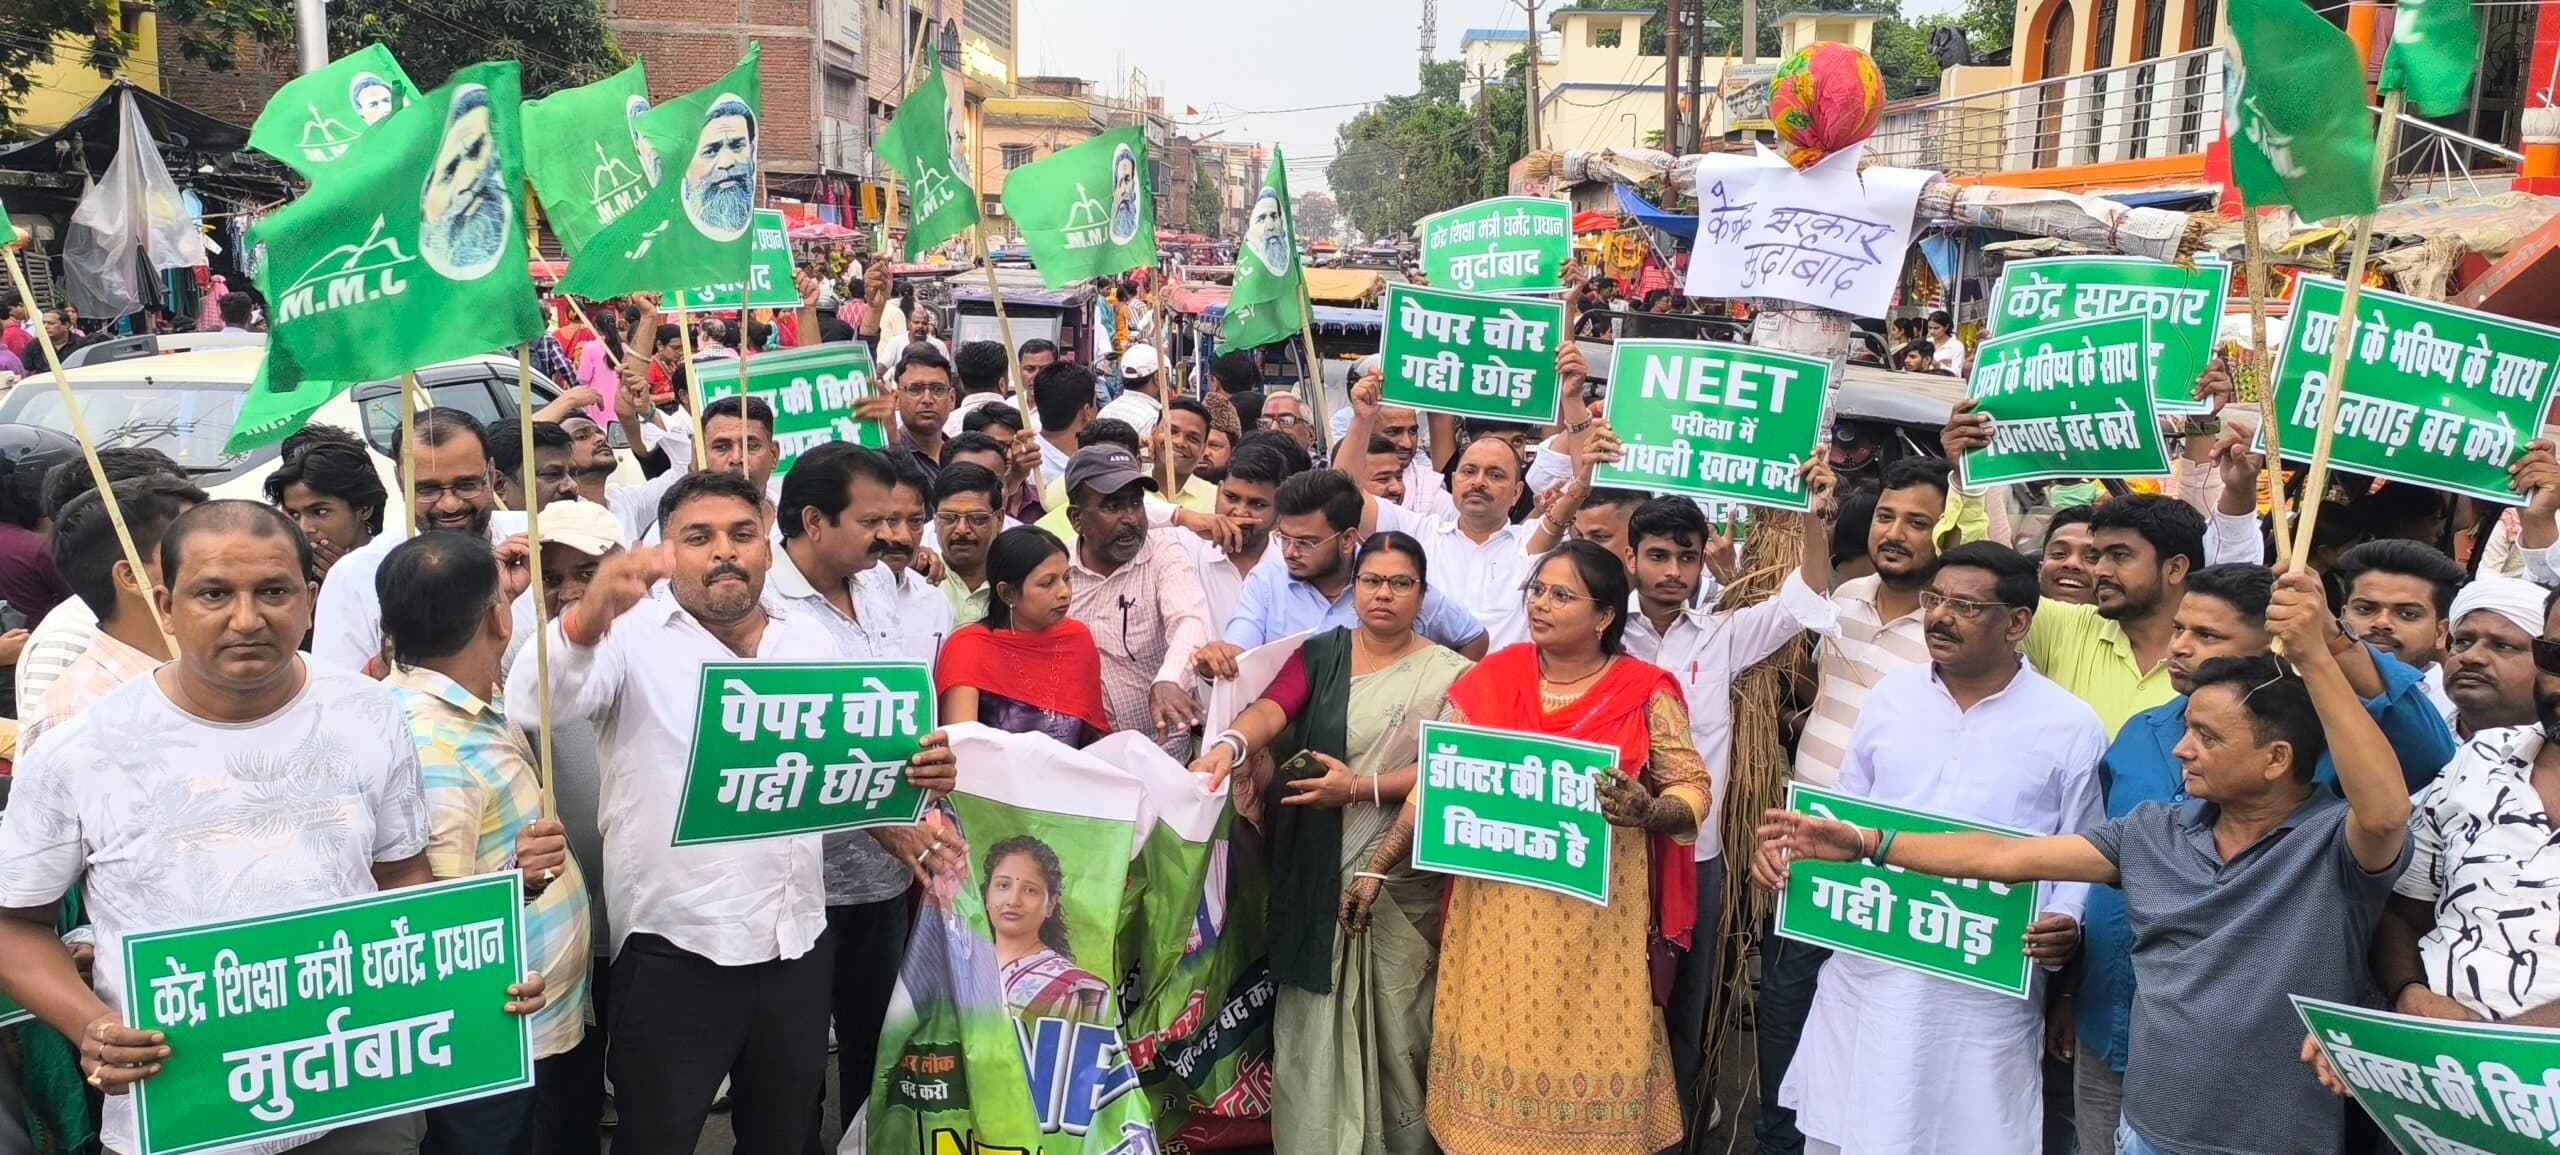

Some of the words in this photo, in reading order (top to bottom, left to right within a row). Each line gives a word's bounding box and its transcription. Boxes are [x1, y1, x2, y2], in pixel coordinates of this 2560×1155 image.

[1431, 225, 1448, 249] केंद्र
[1450, 220, 1476, 244] शिक्षा
[1478, 211, 1500, 239] मंत्री
[1504, 207, 1529, 237] धर्मेंद्र
[1533, 215, 1563, 237] प्रधान
[1449, 243, 1541, 290] मुर्दाबाद
[1400, 296, 1476, 345] पेपर
[1482, 308, 1549, 352] चोर
[2008, 272, 2067, 321] केंद्र
[1401, 351, 1464, 392] गद्दी
[1471, 355, 1537, 406] छोड़
[1641, 355, 1798, 413] NEET
[2004, 348, 2023, 394] के
[2024, 343, 2075, 392] भविष्य
[2077, 336, 2096, 386] के
[2099, 342, 2138, 384] साथ
[2360, 309, 2389, 365] के
[2390, 321, 2464, 383] भविष्य
[2461, 333, 2492, 388] के
[2490, 352, 2548, 401] साथ
[779, 377, 813, 416] की
[2061, 401, 2099, 451] बंद
[2094, 397, 2141, 449] करो
[1671, 411, 1735, 441] परीक्षा
[1739, 416, 1759, 444] में
[2418, 396, 2465, 456] बंद
[2463, 411, 2517, 467] करो
[1699, 450, 1759, 486] खत्म
[721, 679, 833, 742] पेपर
[842, 677, 919, 737] चोर
[717, 752, 813, 812] गद्दी
[818, 748, 907, 810] छोड़
[1428, 743, 1506, 795] डॉक्टर
[1509, 755, 1546, 801] की
[1443, 805, 1560, 860] बिकाऊ
[1558, 821, 1589, 868] है
[1812, 876, 1897, 933] गद्दी
[1908, 890, 1999, 965] छोड़
[150, 957, 206, 1027] केंद्र
[214, 948, 287, 1017] शिक्षा
[295, 930, 352, 1000] मंत्री
[362, 916, 425, 987] धर्मेंद्र
[433, 917, 504, 980] प्रधान
[223, 1006, 454, 1122] मुर्दाबाद
[899, 1075, 916, 1099] बंद
[918, 1079, 949, 1101] करो
[2326, 1028, 2441, 1111] डॉक्टर
[2422, 1054, 2494, 1127] की
